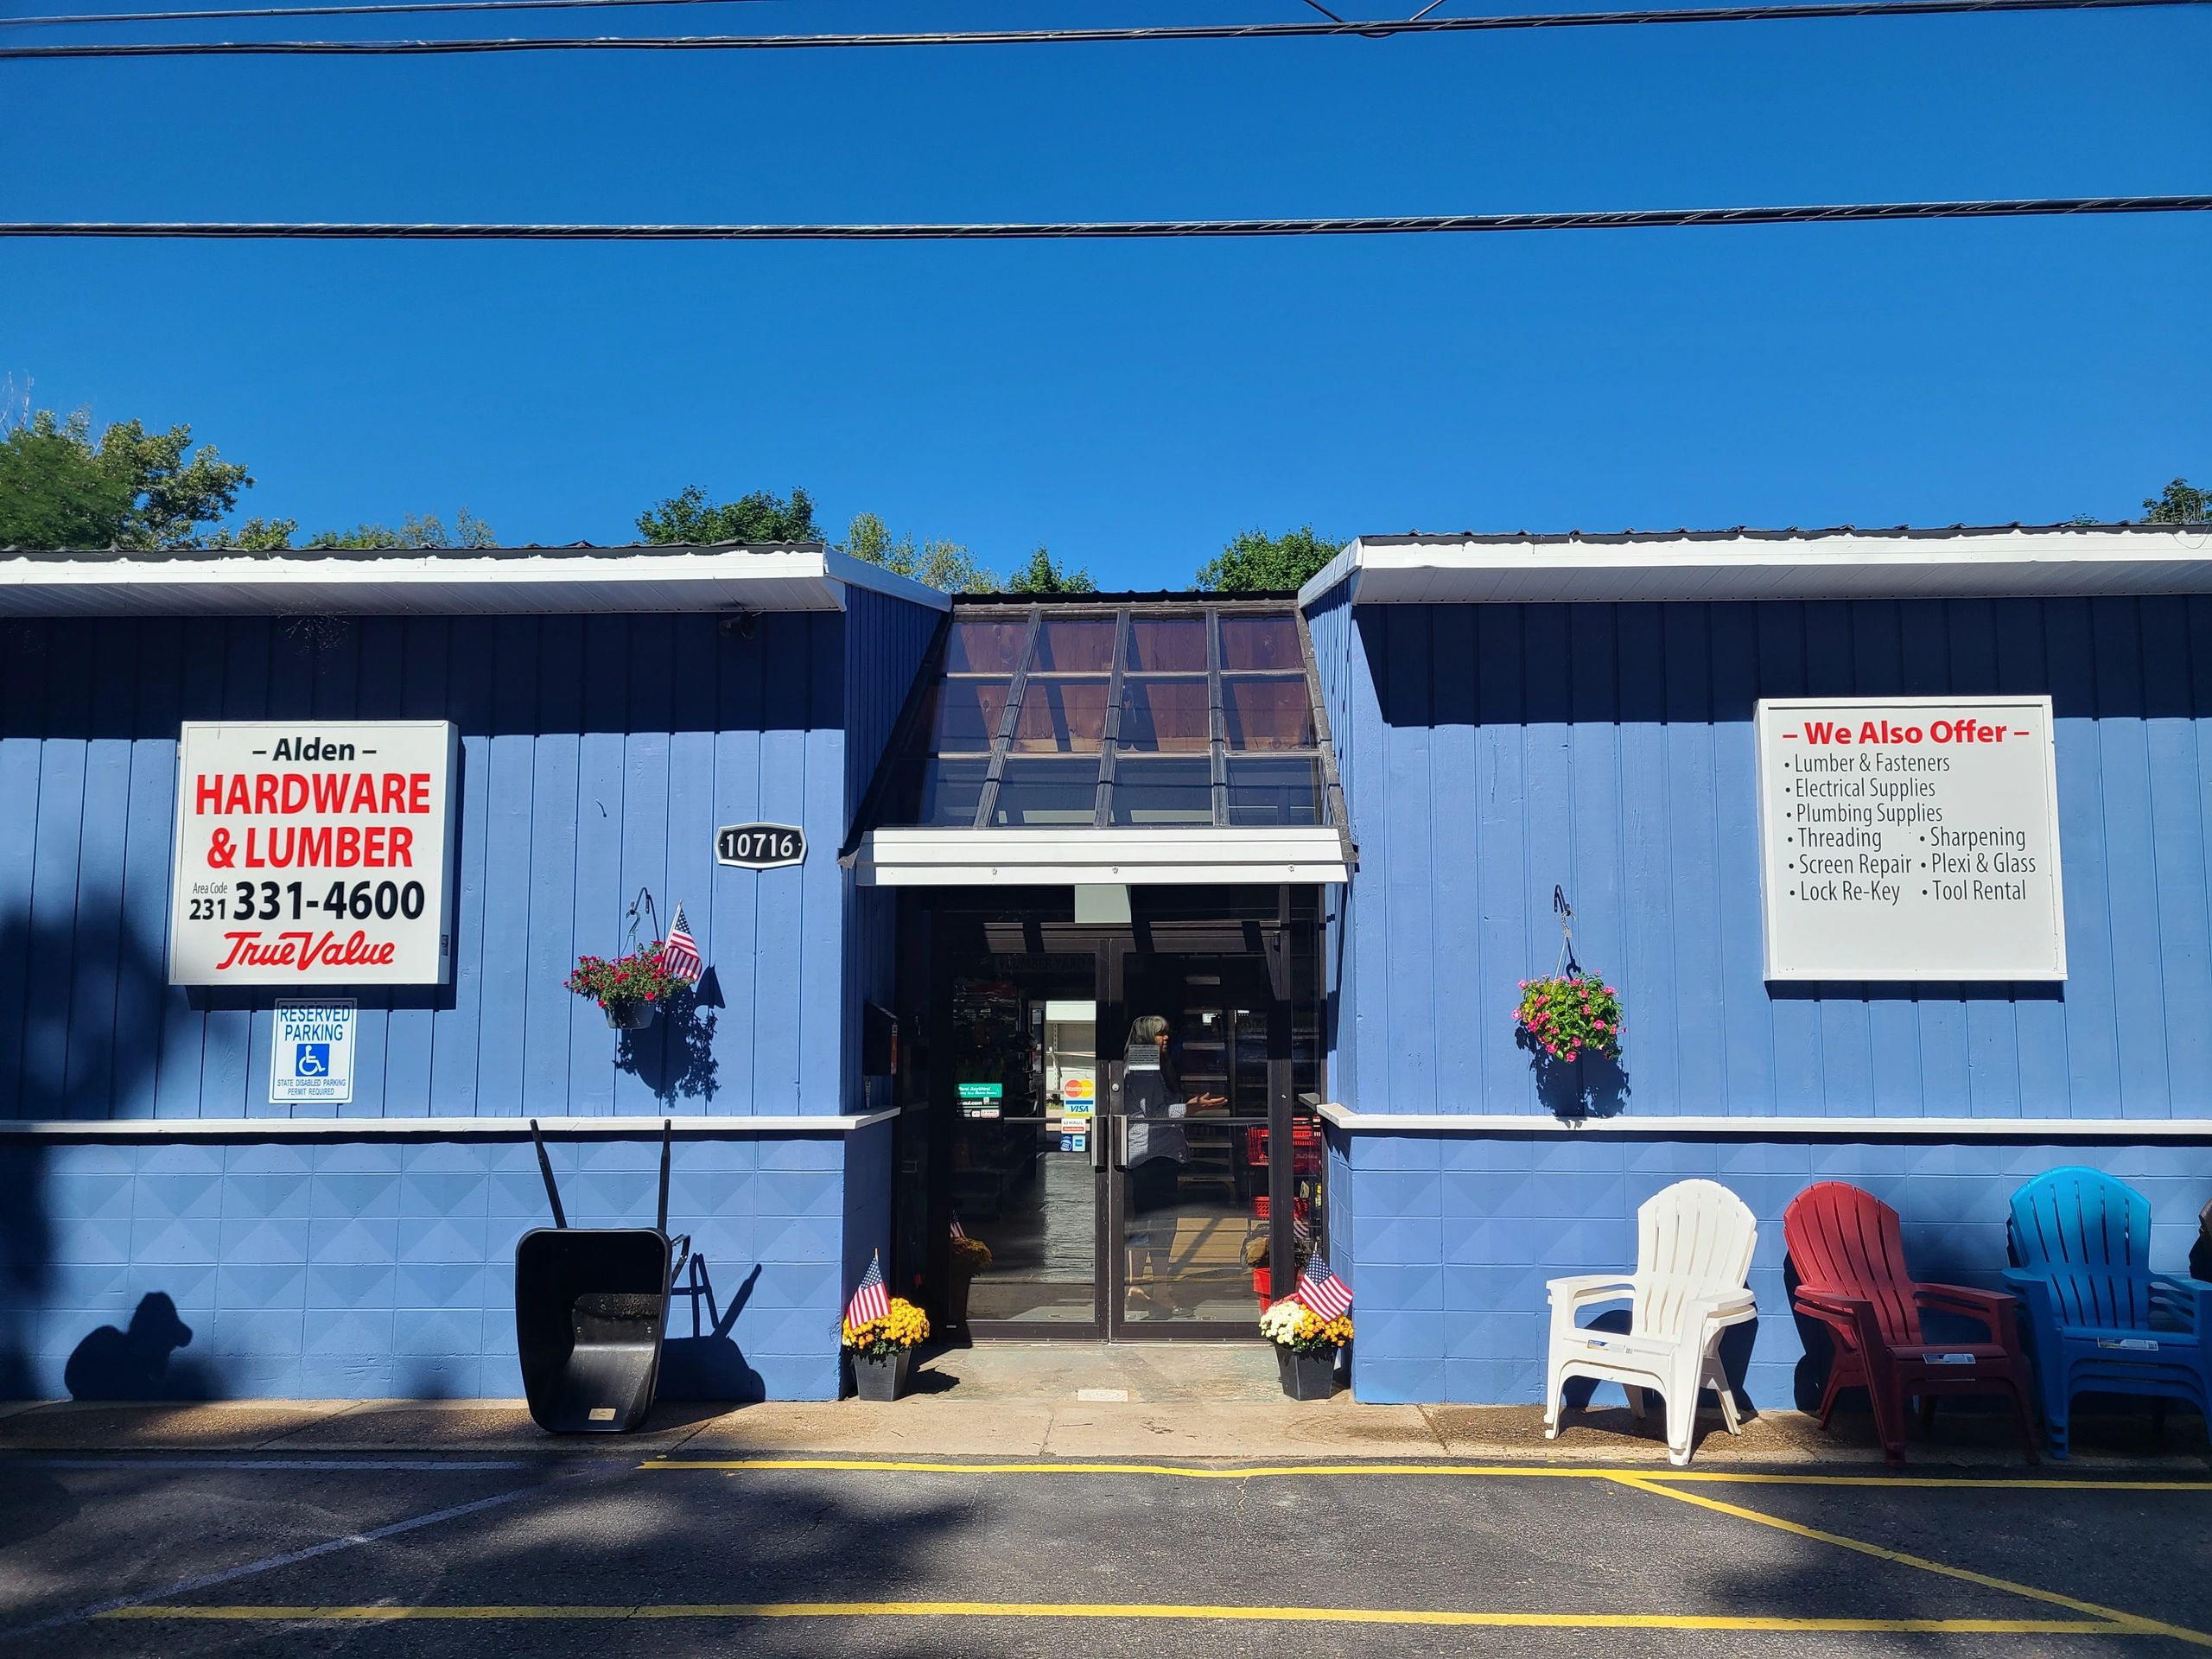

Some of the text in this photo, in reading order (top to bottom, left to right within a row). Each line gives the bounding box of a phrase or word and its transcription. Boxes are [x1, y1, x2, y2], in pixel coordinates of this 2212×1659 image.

[1804, 719, 2006, 744] We Also Offer
[272, 737, 354, 760] Alden
[1796, 753, 1949, 772] Lumber & Fasteners
[196, 773, 430, 815] HARDWARE
[1796, 778, 1935, 801] Electrical Supplies
[1797, 803, 1942, 827] Plumbing Supplies
[207, 827, 412, 868] & LUMBER
[727, 834, 792, 856] 10716
[1798, 827, 1881, 852] Threading
[1931, 826, 2025, 851] Sharpening
[1800, 854, 1911, 879] Screen Repair
[1932, 852, 2036, 873] Plexi & Glass
[193, 882, 227, 893] Area Code
[1802, 880, 1899, 906] Lock Re-Key
[1933, 880, 2025, 899] Tool Rental
[189, 881, 424, 920] 231 331-4600
[280, 1005, 350, 1022] RESERVED
[284, 1024, 344, 1041] PARKING
[296, 1078, 321, 1087] DISABLED
[323, 1078, 346, 1087] PARKING
